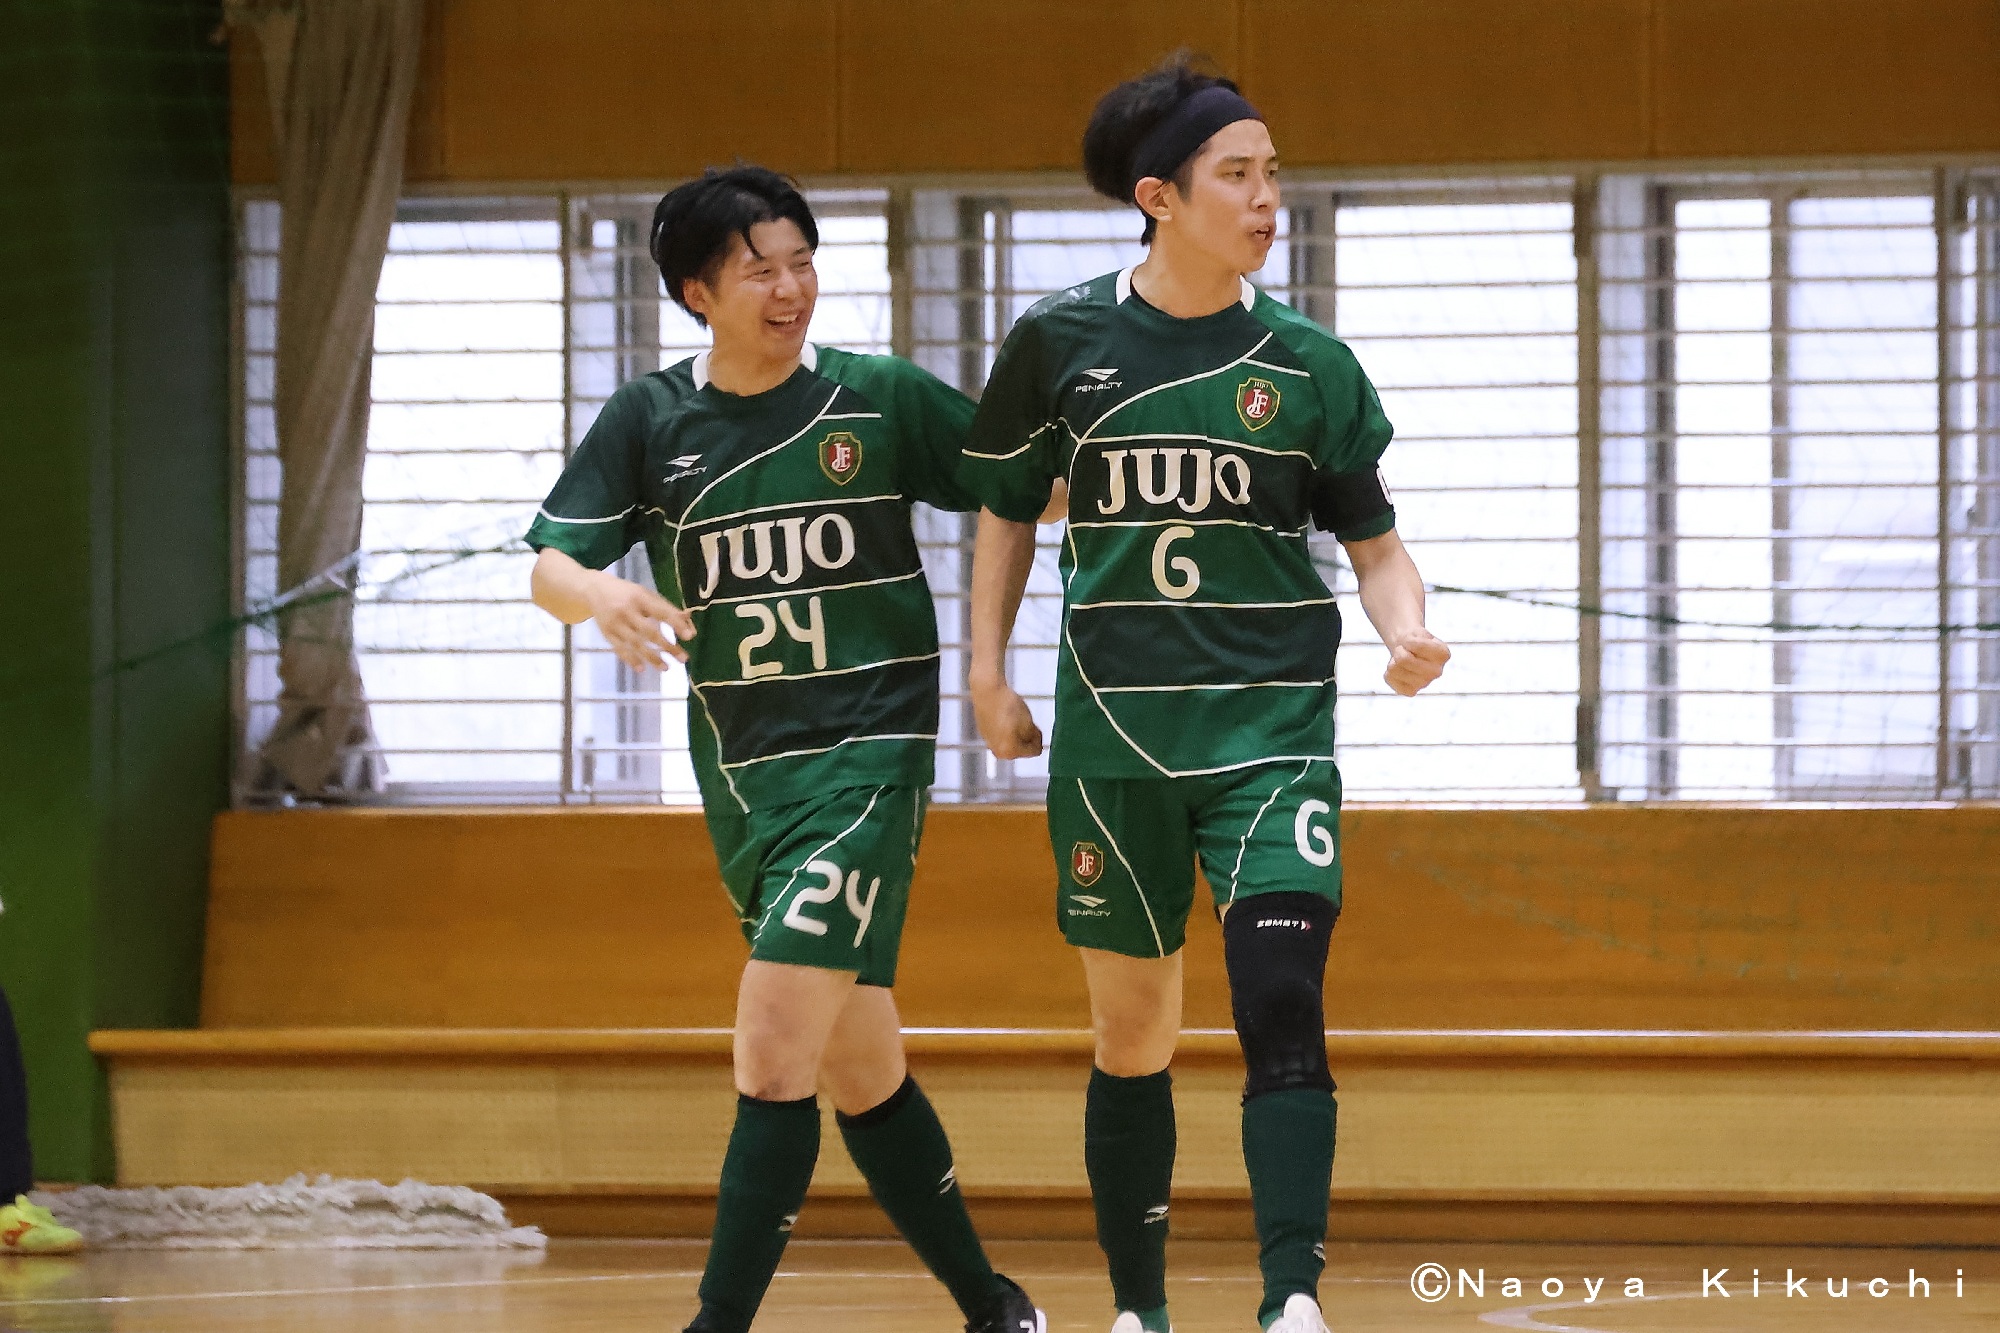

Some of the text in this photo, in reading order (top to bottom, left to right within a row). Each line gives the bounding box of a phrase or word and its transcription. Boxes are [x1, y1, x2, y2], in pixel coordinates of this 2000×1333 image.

[1075, 381, 1122, 393] PENALTY
[1097, 448, 1251, 515] JUJO
[699, 513, 856, 600] JUJO
[1152, 526, 1200, 600] 6
[735, 596, 827, 679] 24
[1294, 799, 1335, 867] 6
[782, 860, 881, 949] 24
